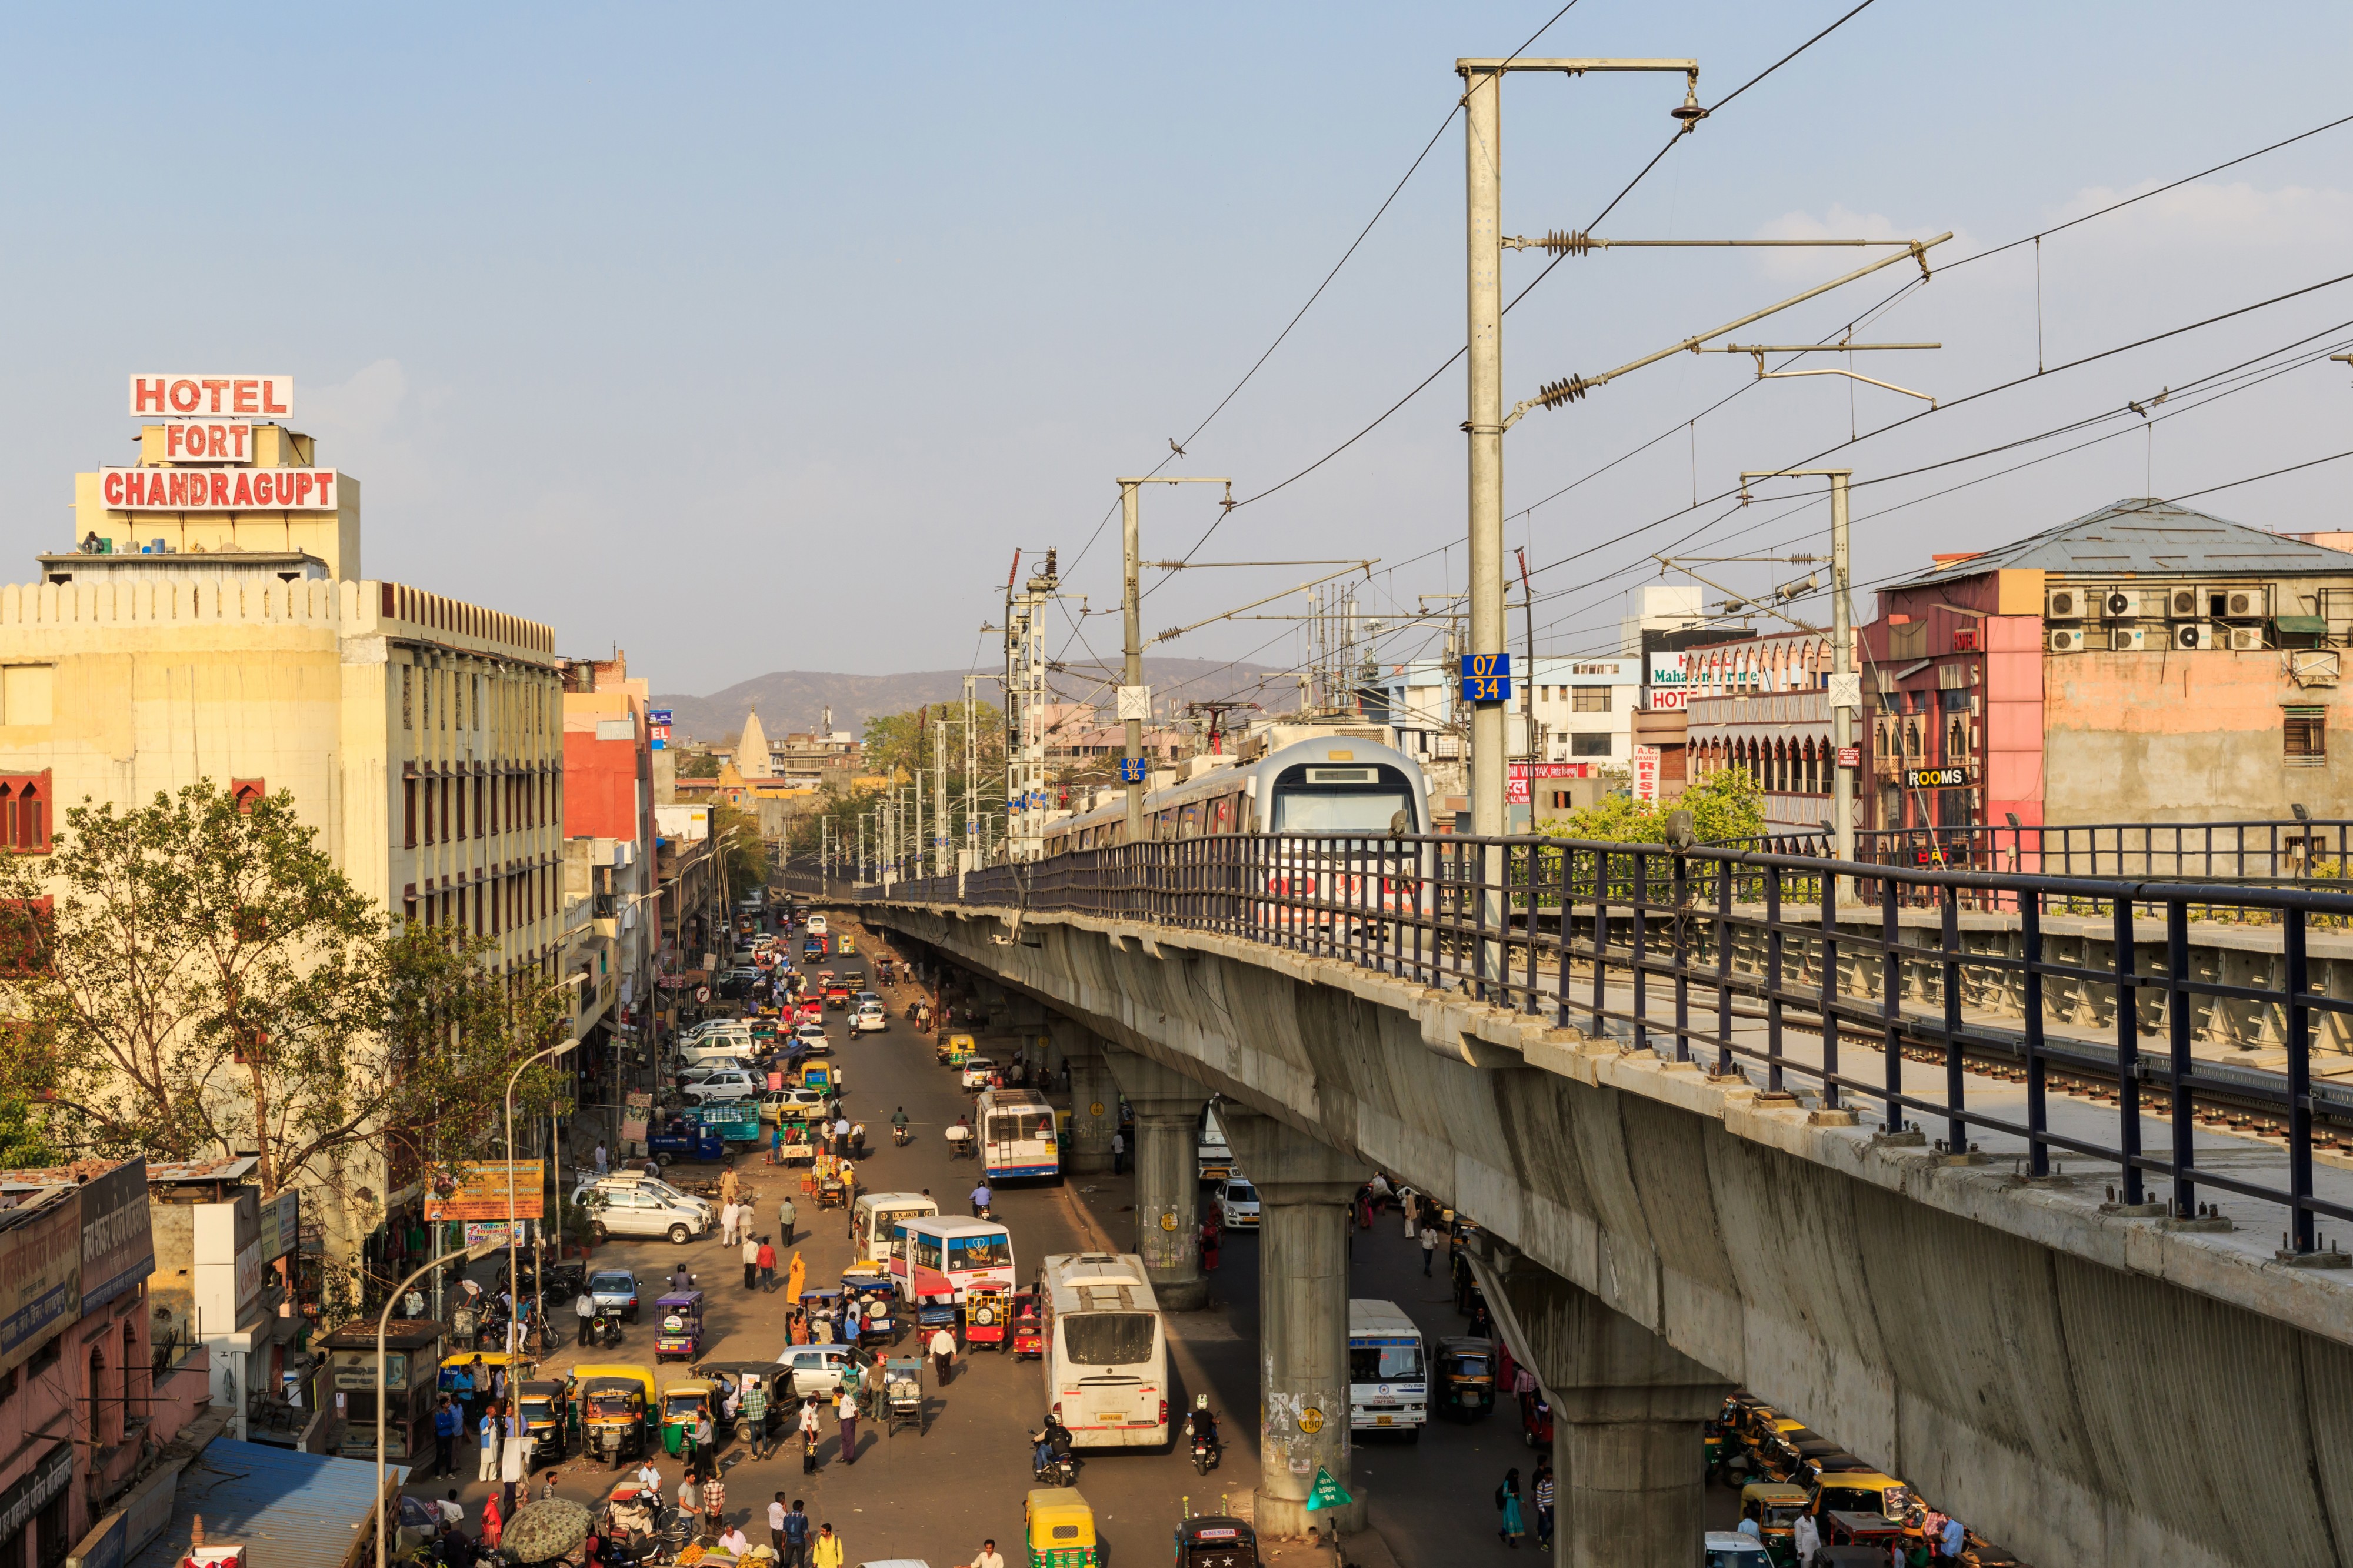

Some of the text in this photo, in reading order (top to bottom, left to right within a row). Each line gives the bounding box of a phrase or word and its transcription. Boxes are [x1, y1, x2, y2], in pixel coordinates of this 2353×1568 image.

[136, 379, 287, 413] HOTEL
[168, 425, 248, 457] FORT
[104, 472, 333, 506] CHANDRAGUPT
[1954, 631, 1979, 651] HOTEL
[1473, 655, 1498, 676] 07
[1474, 678, 1499, 699] 34
[1832, 676, 1849, 692] WORKING
[1849, 690, 1859, 700] LIMIT
[1845, 675, 1855, 686] BLOCK
[1122, 688, 1139, 705] WORKING
[1831, 688, 1843, 702] POWER
[1119, 701, 1132, 715] POWER
[650, 727, 668, 739] EL
[1126, 759, 1139, 769] 07
[1128, 770, 1140, 780] 36
[1909, 769, 1962, 786] ROOMS
[1304, 1420, 1320, 1429] 190
[1202, 1529, 1235, 1537] ANISHA
